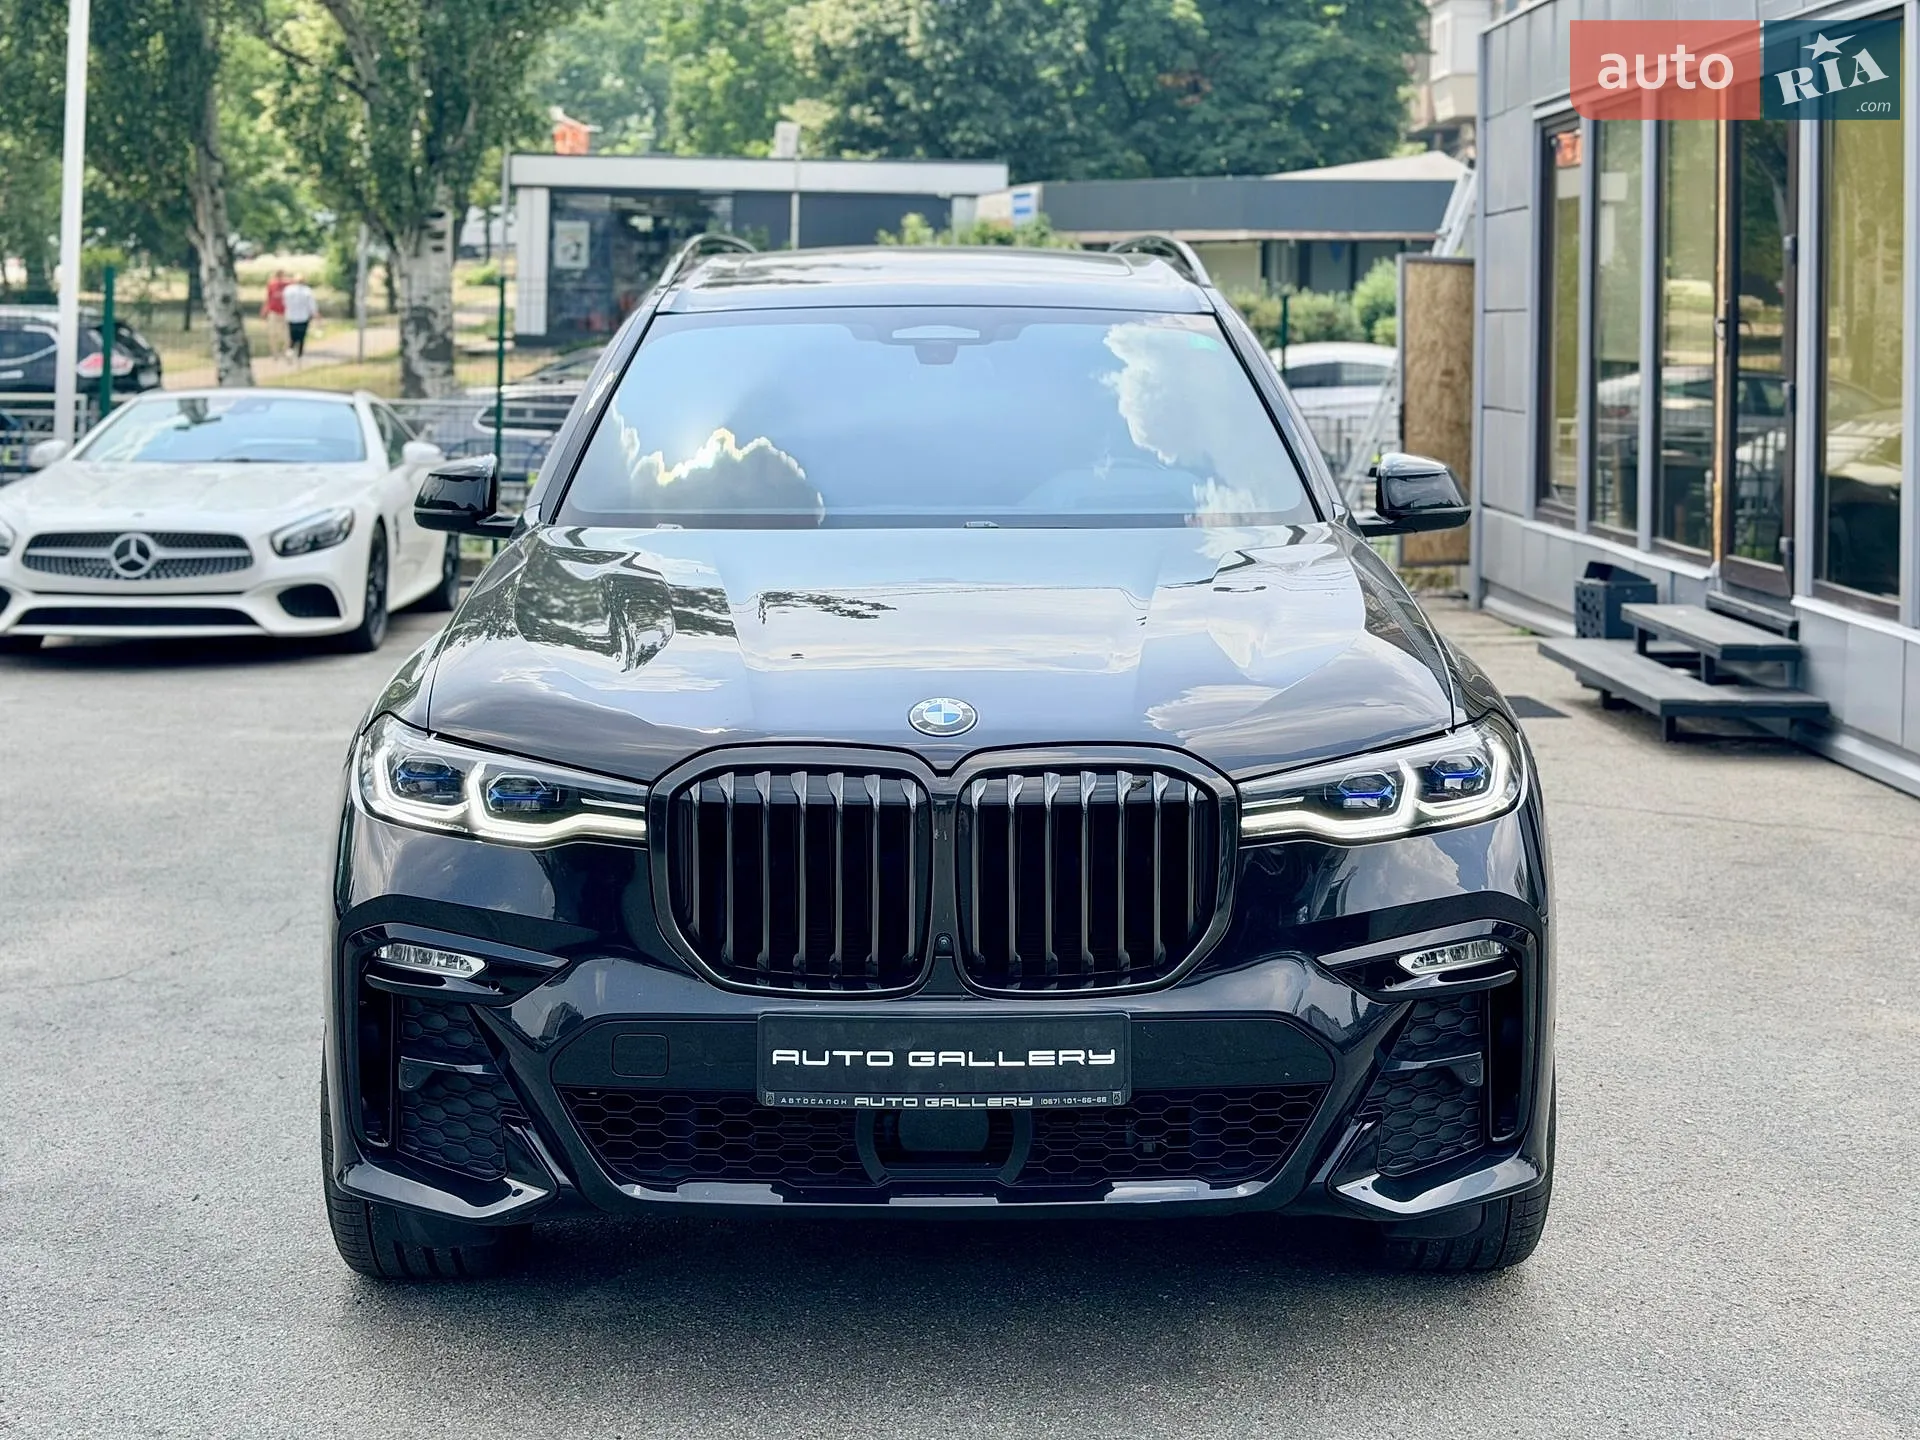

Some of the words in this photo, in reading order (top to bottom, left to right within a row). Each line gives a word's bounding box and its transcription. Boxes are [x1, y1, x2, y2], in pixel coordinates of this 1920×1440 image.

[772, 1049, 894, 1067] AUTO
[908, 1049, 1116, 1067] GALLERY
[854, 1097, 918, 1107] AUTO
[925, 1097, 1033, 1107] GALLERY
